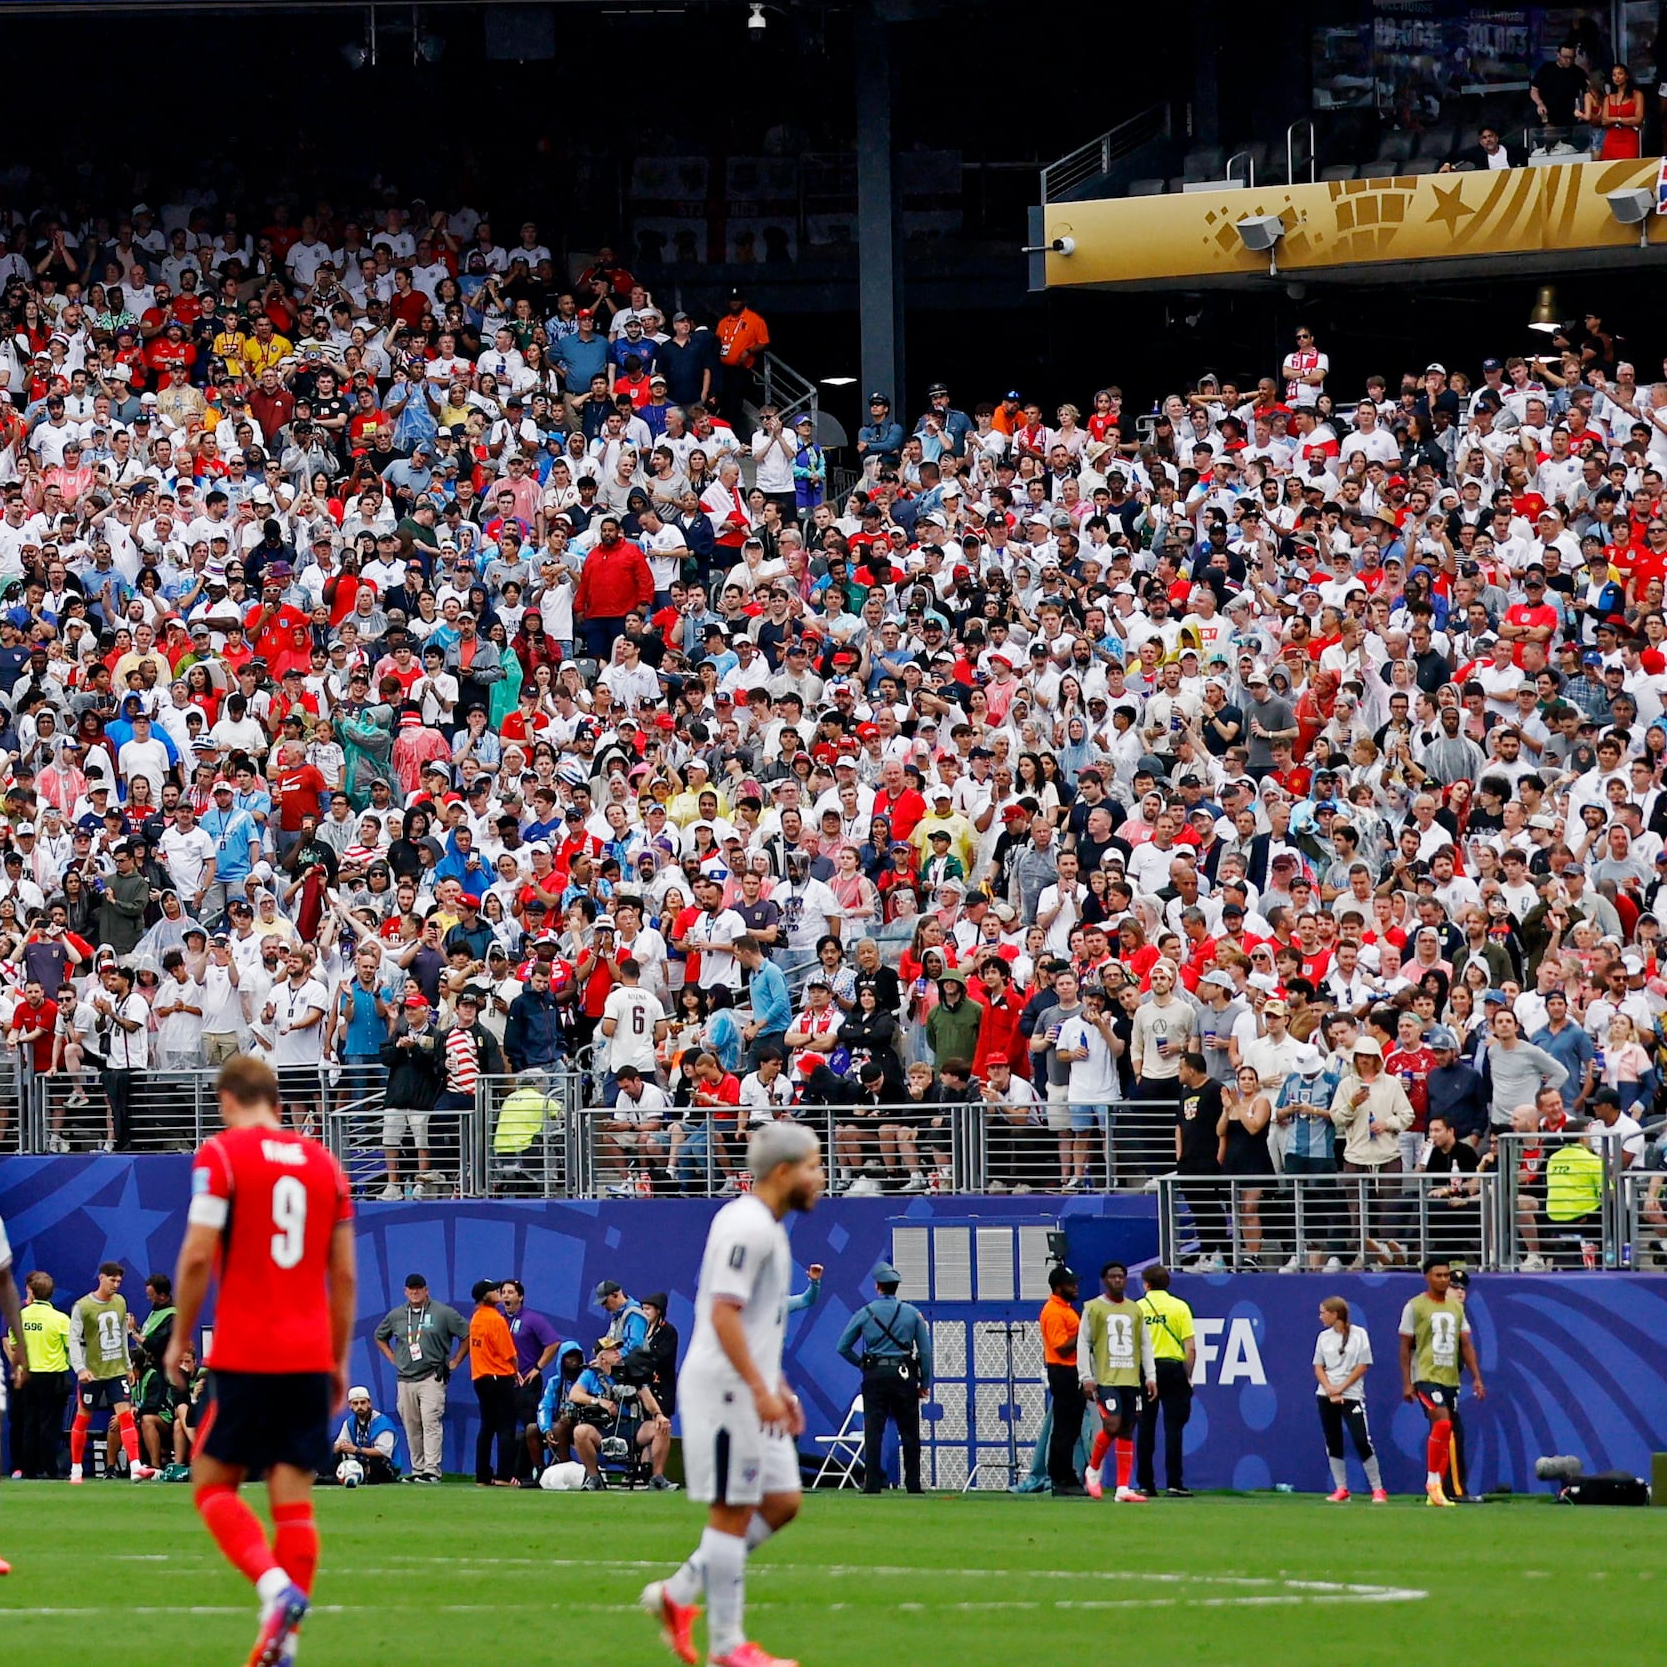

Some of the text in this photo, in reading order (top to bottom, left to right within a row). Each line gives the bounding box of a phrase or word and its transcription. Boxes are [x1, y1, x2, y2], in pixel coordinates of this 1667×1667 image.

[631, 1006, 645, 1035] 6
[272, 1175, 309, 1269] 9
[24, 1320, 43, 1332] 596
[1193, 1318, 1266, 1386] FA
